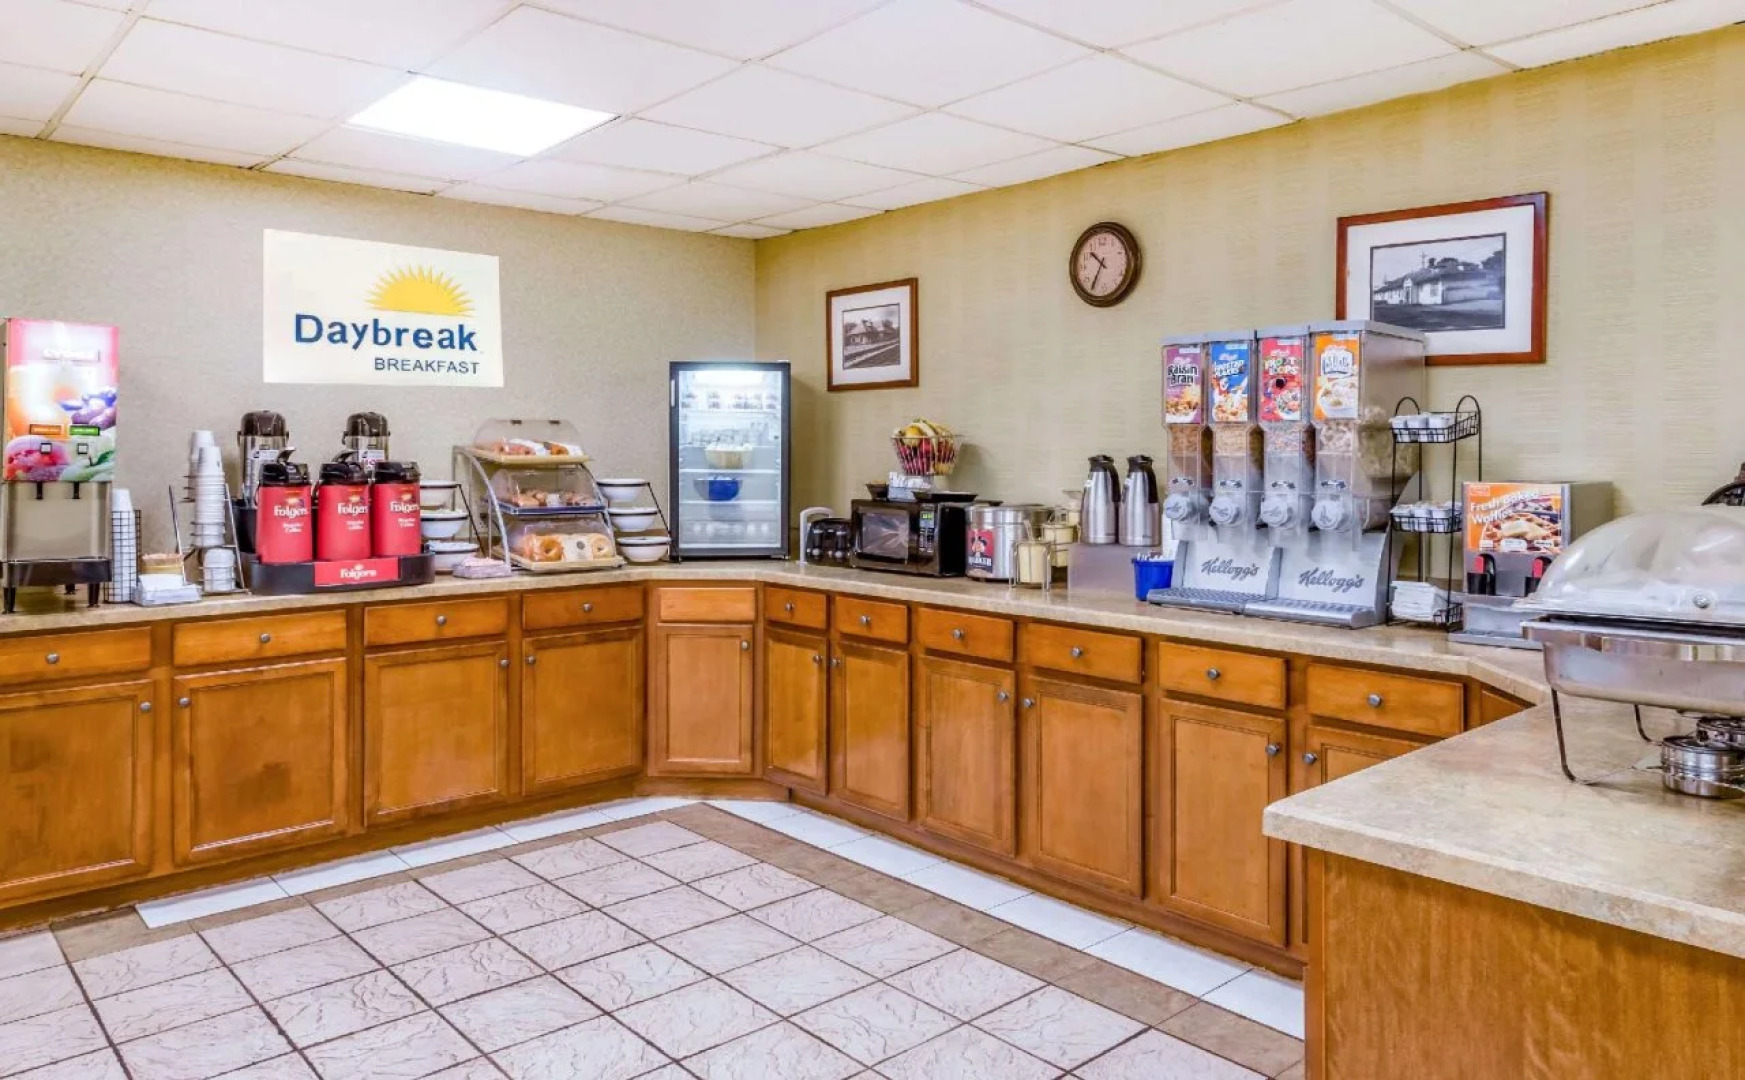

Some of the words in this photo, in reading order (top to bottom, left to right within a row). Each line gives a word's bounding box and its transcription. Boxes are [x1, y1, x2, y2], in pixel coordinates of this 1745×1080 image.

[295, 313, 478, 351] Daybreak
[374, 357, 480, 374] BREAKFAST
[1167, 364, 1198, 376] Raisin
[1169, 374, 1195, 385] Bran
[337, 502, 369, 516] Folger
[390, 501, 420, 513] Folger
[1470, 497, 1499, 512] Fresh
[273, 505, 308, 519] Folgers
[340, 568, 377, 580] Folgers
[1201, 556, 1259, 580] Kellogg's
[1299, 567, 1365, 592] Kellogg's
